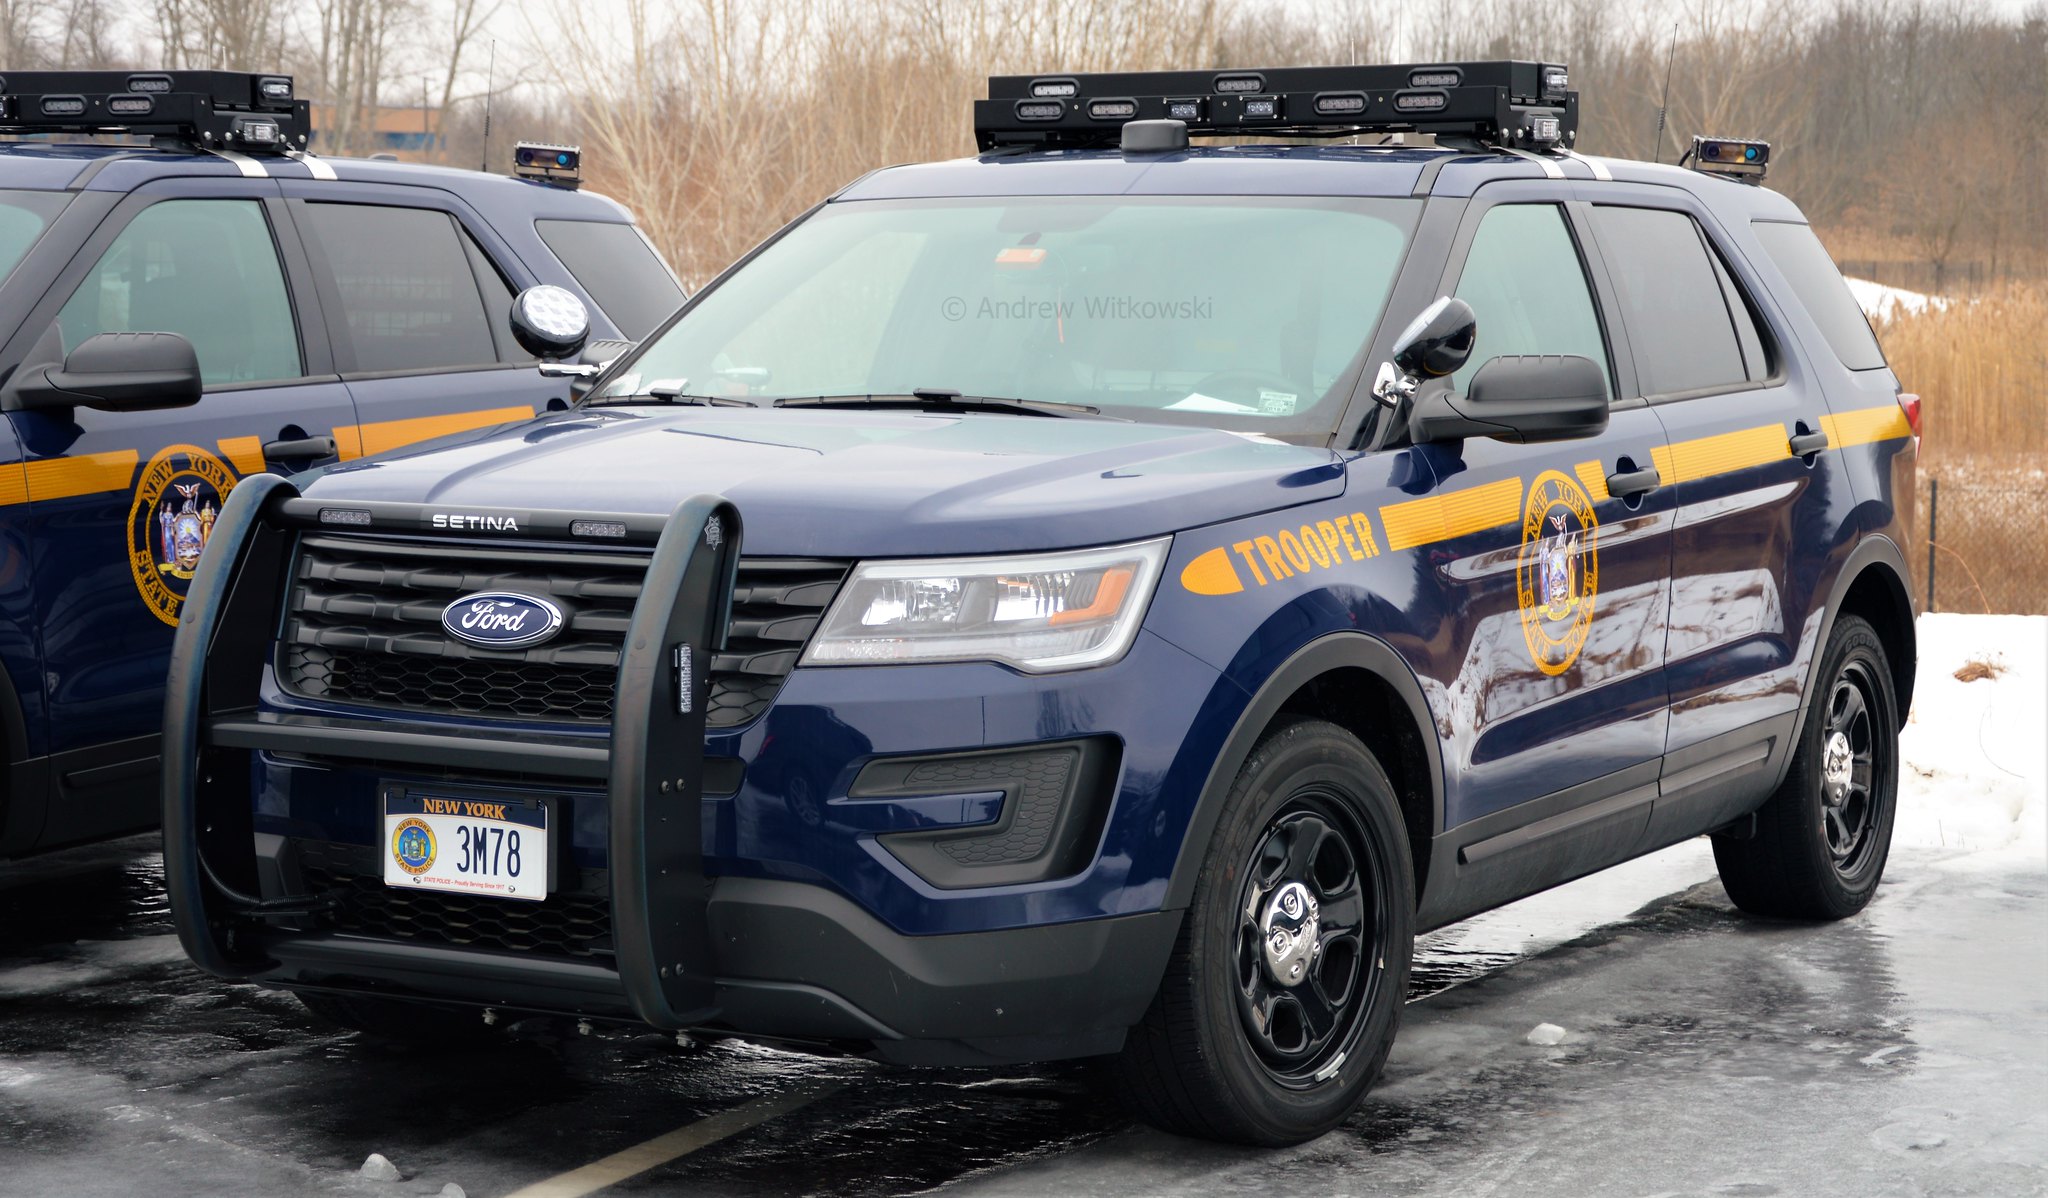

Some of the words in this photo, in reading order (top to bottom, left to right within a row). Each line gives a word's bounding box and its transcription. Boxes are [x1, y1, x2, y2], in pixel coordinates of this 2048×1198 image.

[143, 456, 175, 508] NEW
[186, 452, 233, 499] YORK
[432, 514, 519, 532] SETINA
[1526, 484, 1548, 541] NEW
[1555, 480, 1593, 527] YORK
[1232, 511, 1380, 586] TROOPER
[135, 550, 180, 618] STATE
[461, 600, 530, 632] Ford
[1520, 588, 1550, 662] STATE
[398, 820, 412, 832] NEW
[415, 820, 431, 832] YORK
[423, 798, 461, 814] NEW
[464, 802, 506, 820] YORK
[396, 853, 412, 873] STATE
[414, 858, 433, 873] POLICE
[456, 825, 521, 878] 3M78
